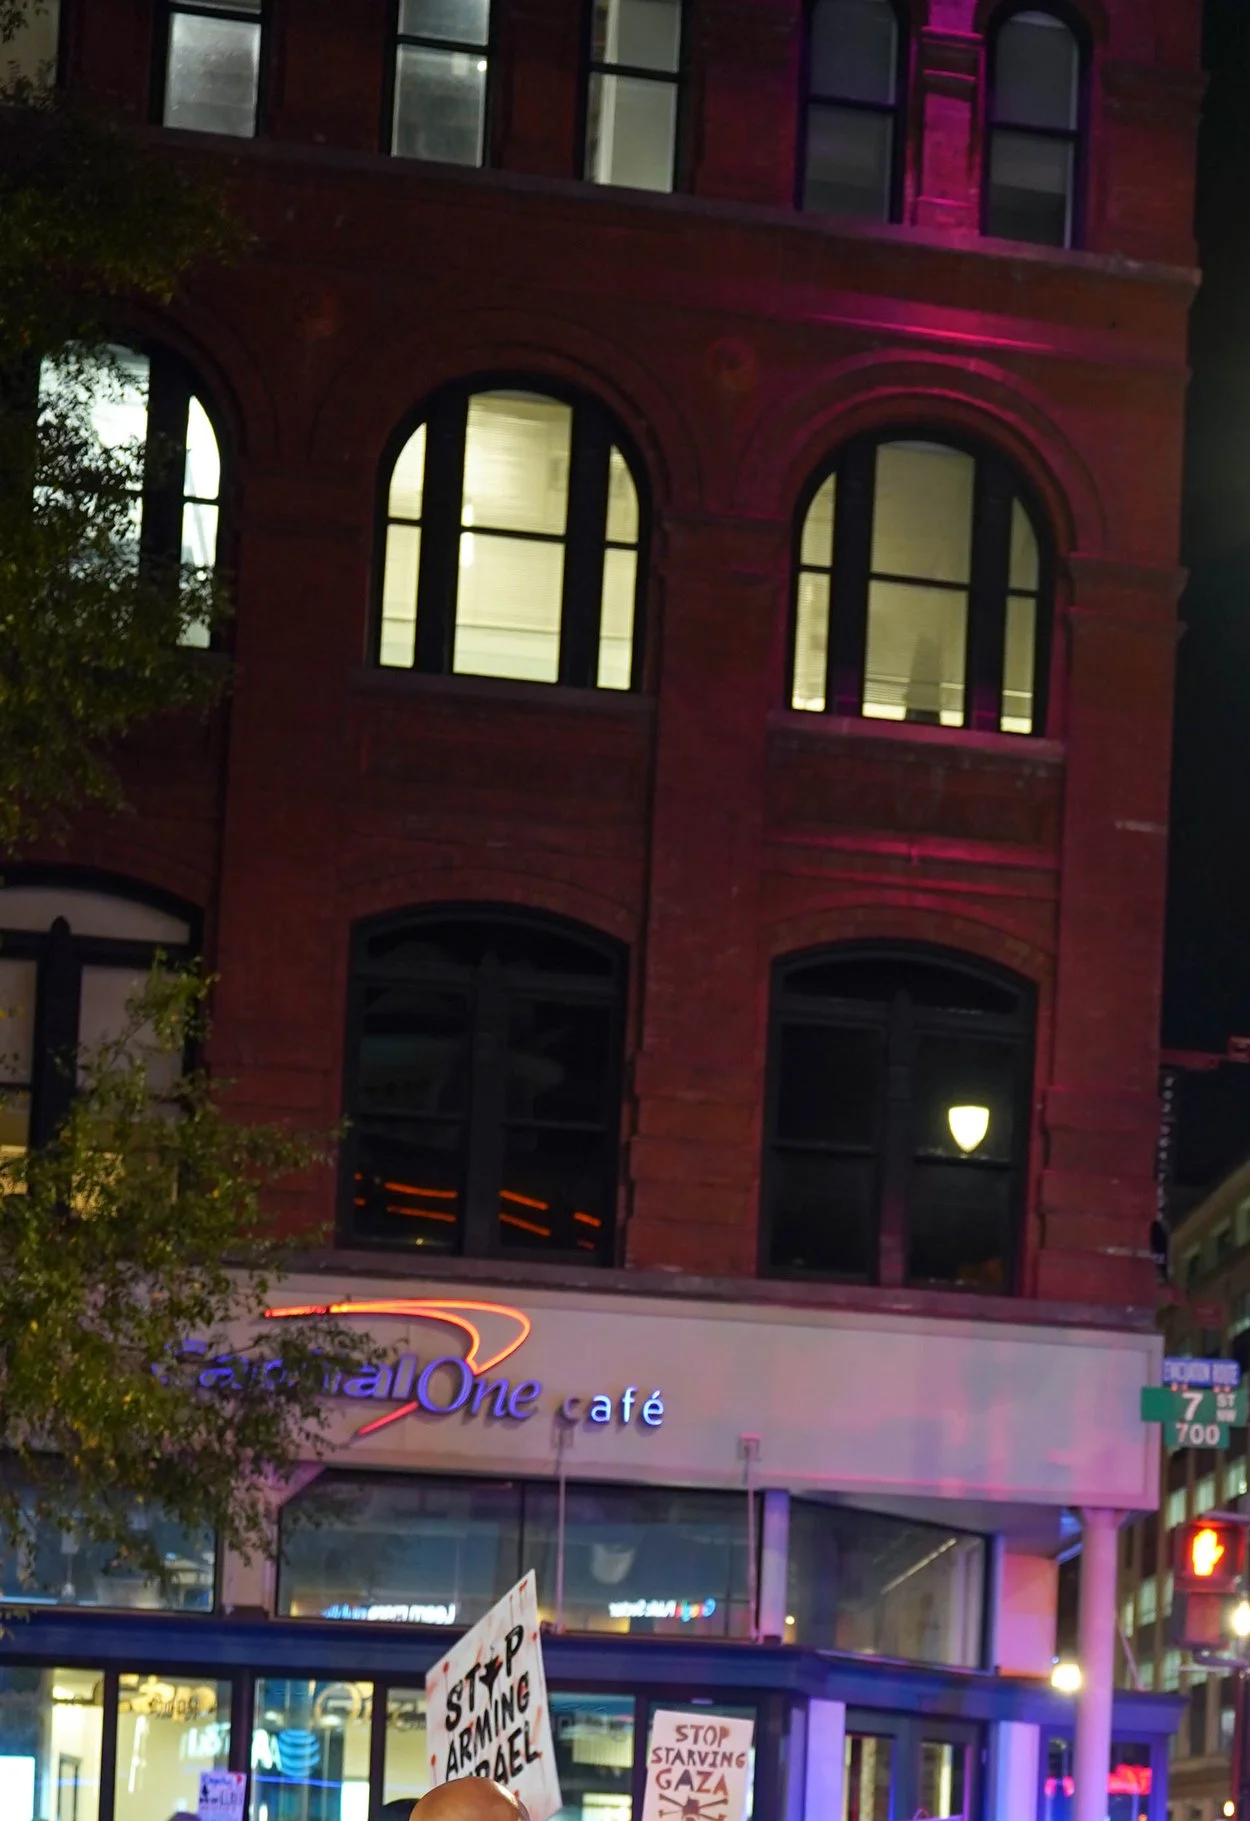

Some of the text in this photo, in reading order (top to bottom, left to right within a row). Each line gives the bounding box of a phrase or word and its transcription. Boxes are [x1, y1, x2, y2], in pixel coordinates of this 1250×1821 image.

[558, 1387, 664, 1427] café
[1182, 1392, 1236, 1421] 7 ST
[1176, 1422, 1220, 1446] 700
[446, 1671, 530, 1782] ARMING
[675, 1724, 731, 1748] STOP
[651, 1747, 747, 1769] STARVING
[655, 1767, 729, 1796] GAZA
